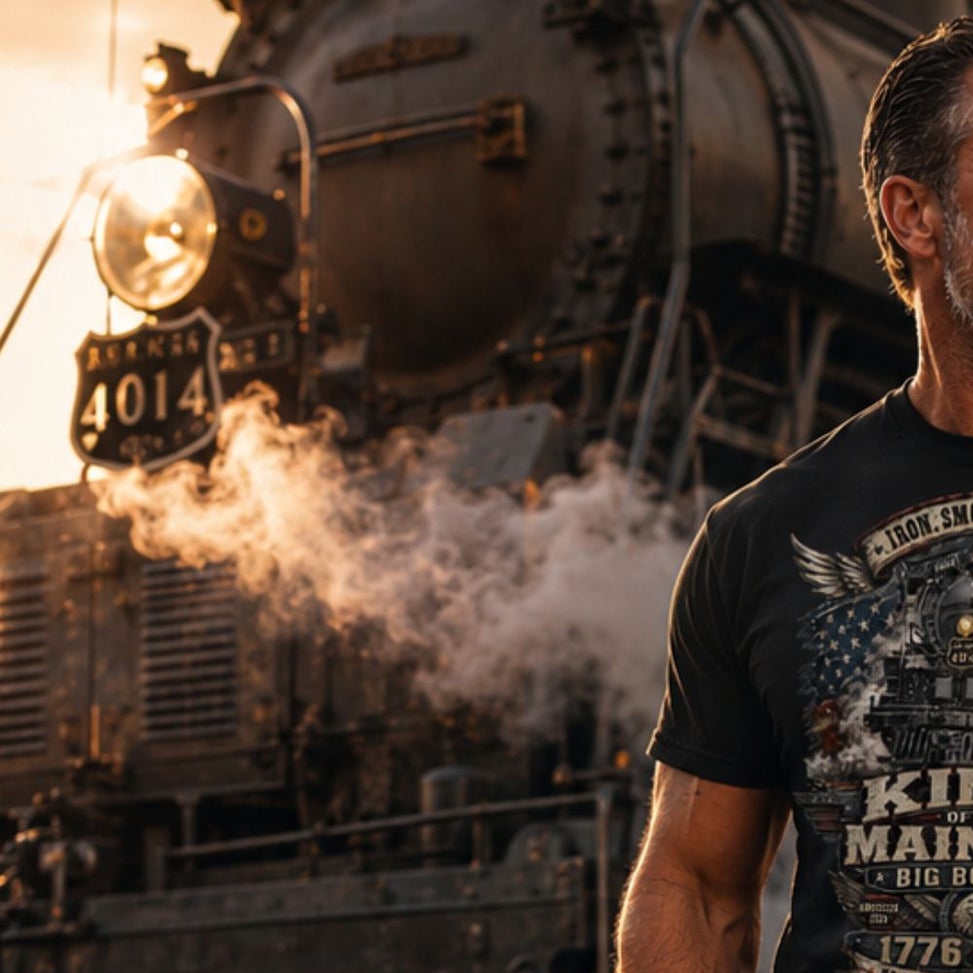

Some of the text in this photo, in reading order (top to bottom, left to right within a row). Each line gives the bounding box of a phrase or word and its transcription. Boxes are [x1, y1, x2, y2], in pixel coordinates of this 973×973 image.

[80, 366, 208, 432] 4014
[884, 511, 939, 549] IRON.
[946, 811, 973, 824] OF
[896, 867, 940, 888] BIG
[880, 936, 962, 967] 1776
